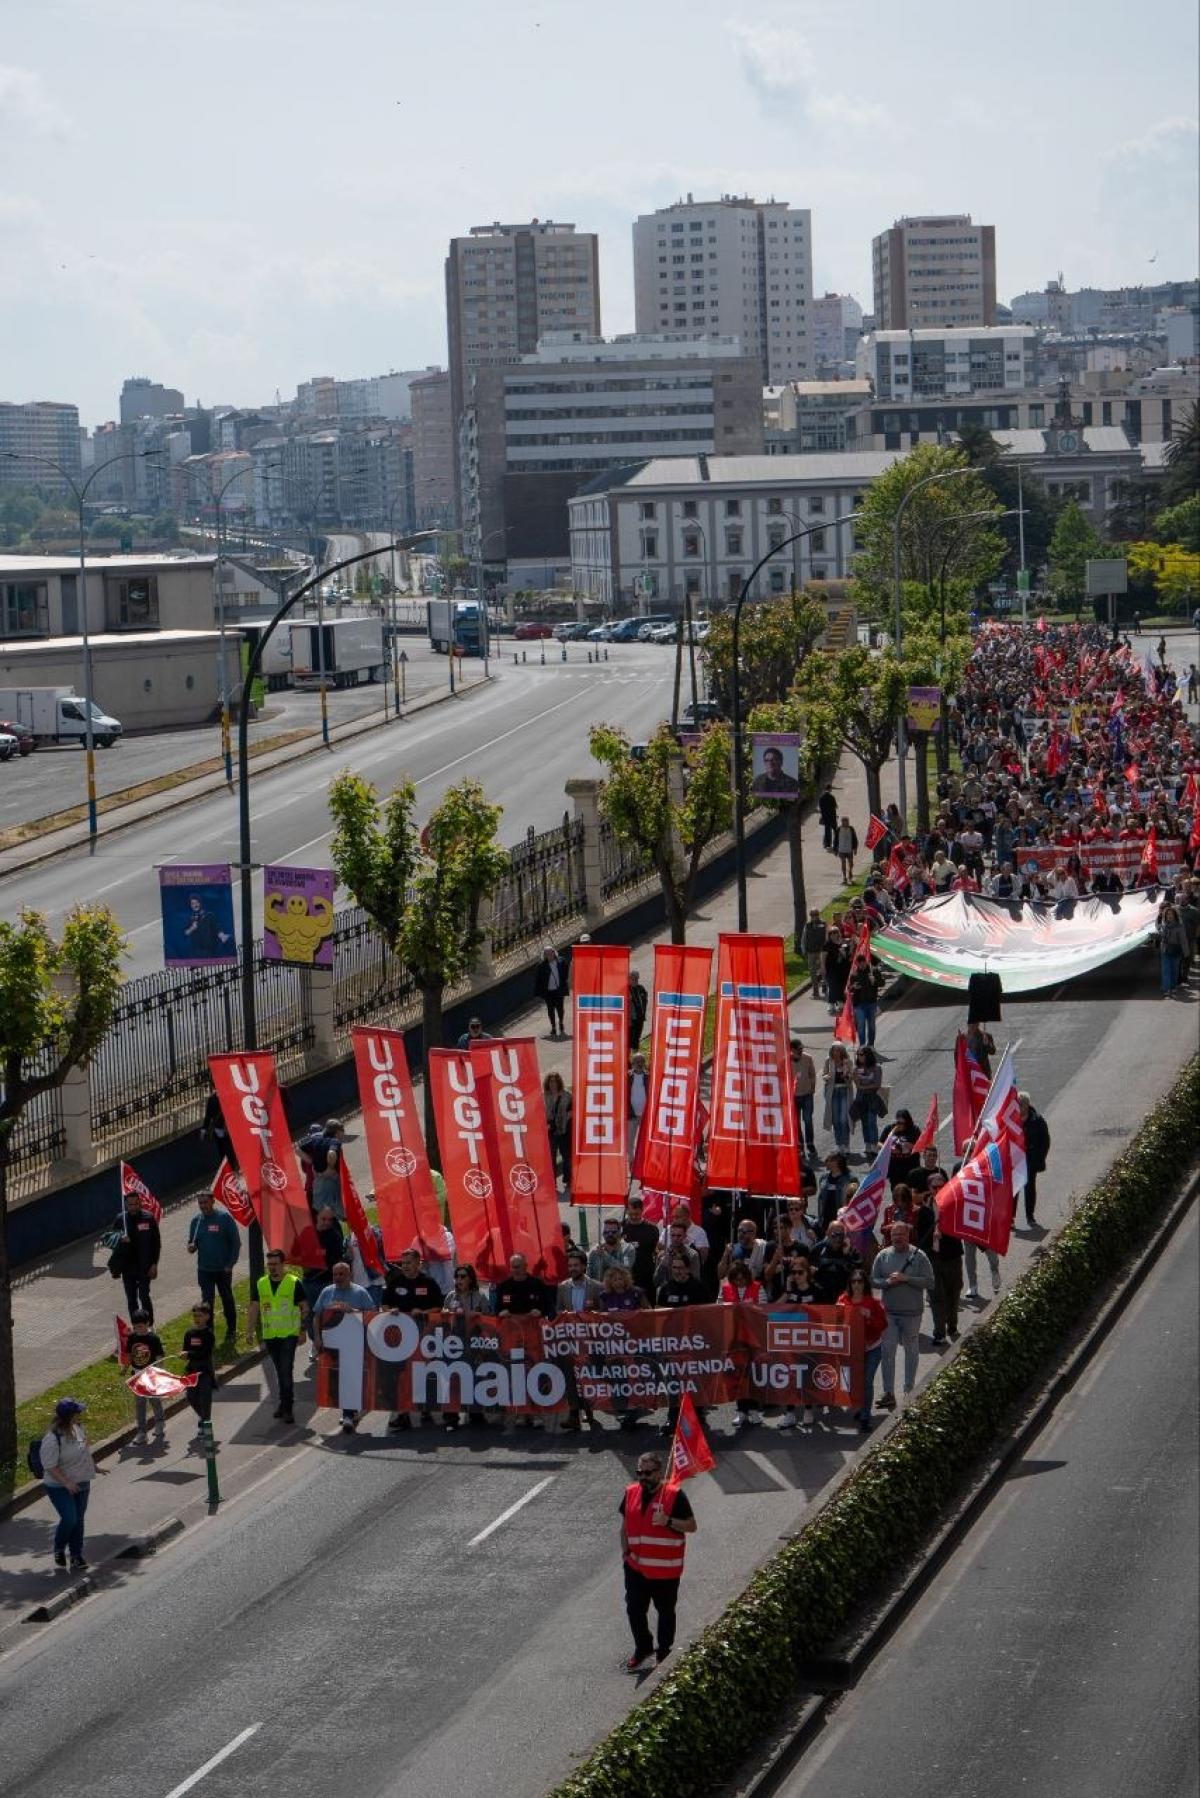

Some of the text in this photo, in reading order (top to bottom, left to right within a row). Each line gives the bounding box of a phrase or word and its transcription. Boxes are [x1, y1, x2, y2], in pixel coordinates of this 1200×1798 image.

[367, 1038, 405, 1143] UGT
[586, 1022, 614, 1144] CCOO
[658, 1017, 692, 1136] CCOO
[749, 1012, 783, 1136] CCOO
[229, 1064, 272, 1159] UGT
[447, 1061, 484, 1164] UGT
[491, 1049, 528, 1158] UGT
[420, 1326, 464, 1360] de
[470, 1336, 499, 1350] 2026
[542, 1322, 631, 1341] DEREITOS,
[543, 1335, 711, 1360] NON TRINCHEIRAS.
[773, 1327, 844, 1348] CCOO
[411, 1347, 566, 1408] maio
[574, 1357, 736, 1380] SALARIOS, VIVENDA
[584, 1379, 698, 1399] DEMOCRACIA
[751, 1361, 809, 1389] UGT
